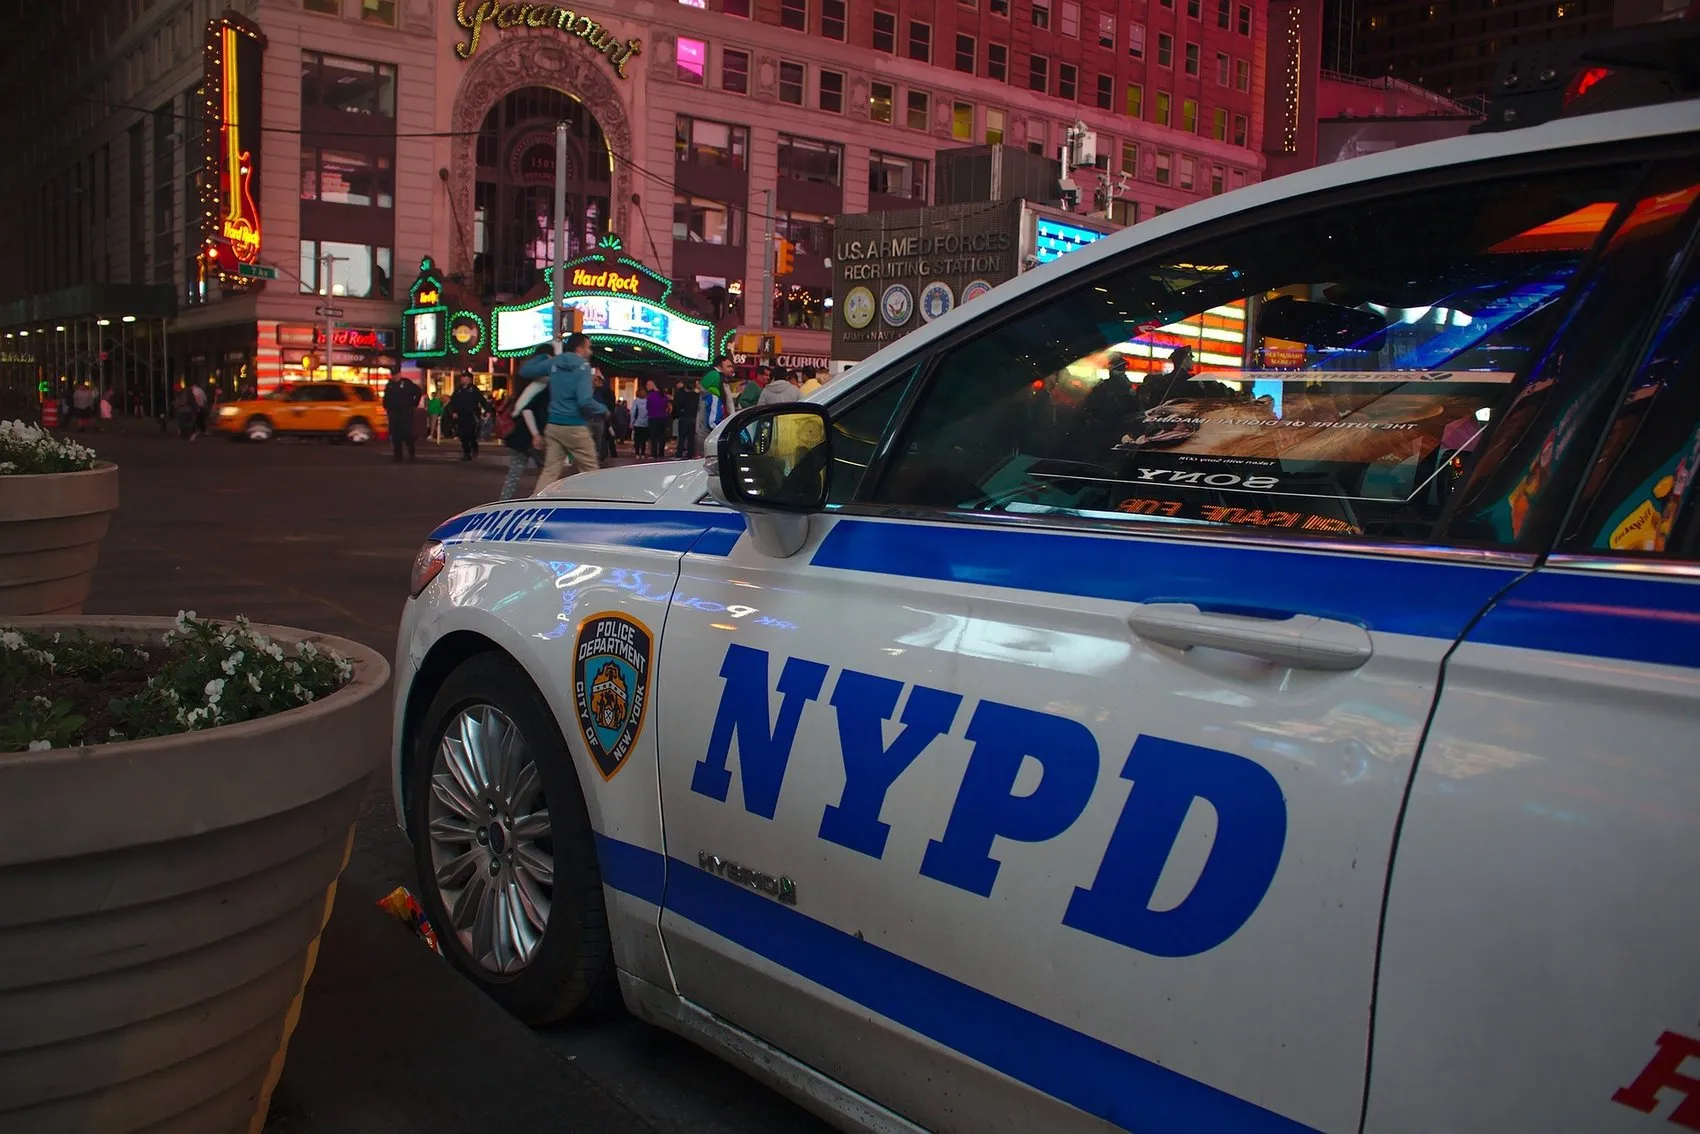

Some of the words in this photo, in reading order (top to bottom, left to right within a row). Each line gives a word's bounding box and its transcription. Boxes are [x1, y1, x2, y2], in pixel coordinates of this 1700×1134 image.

[456, 0, 641, 79] Paramount
[837, 241, 865, 261] U.S.
[867, 236, 932, 260] ARMED
[934, 232, 1011, 255] FORCES
[572, 269, 607, 288] Hard
[606, 272, 640, 293] Rock
[844, 260, 930, 281] RECRUITING
[932, 256, 1001, 275] STATION
[842, 332, 866, 341] ARMY
[870, 330, 896, 341] NAVY
[458, 508, 557, 541] POLICE
[596, 621, 636, 645] POLICE
[578, 637, 646, 674] DEPARTMENT
[576, 681, 589, 719] CITY
[585, 728, 599, 747] OF
[613, 730, 632, 761] NEW
[629, 684, 645, 726] YORK
[690, 642, 1288, 957] NYPD
[698, 850, 779, 896] HYBRID
